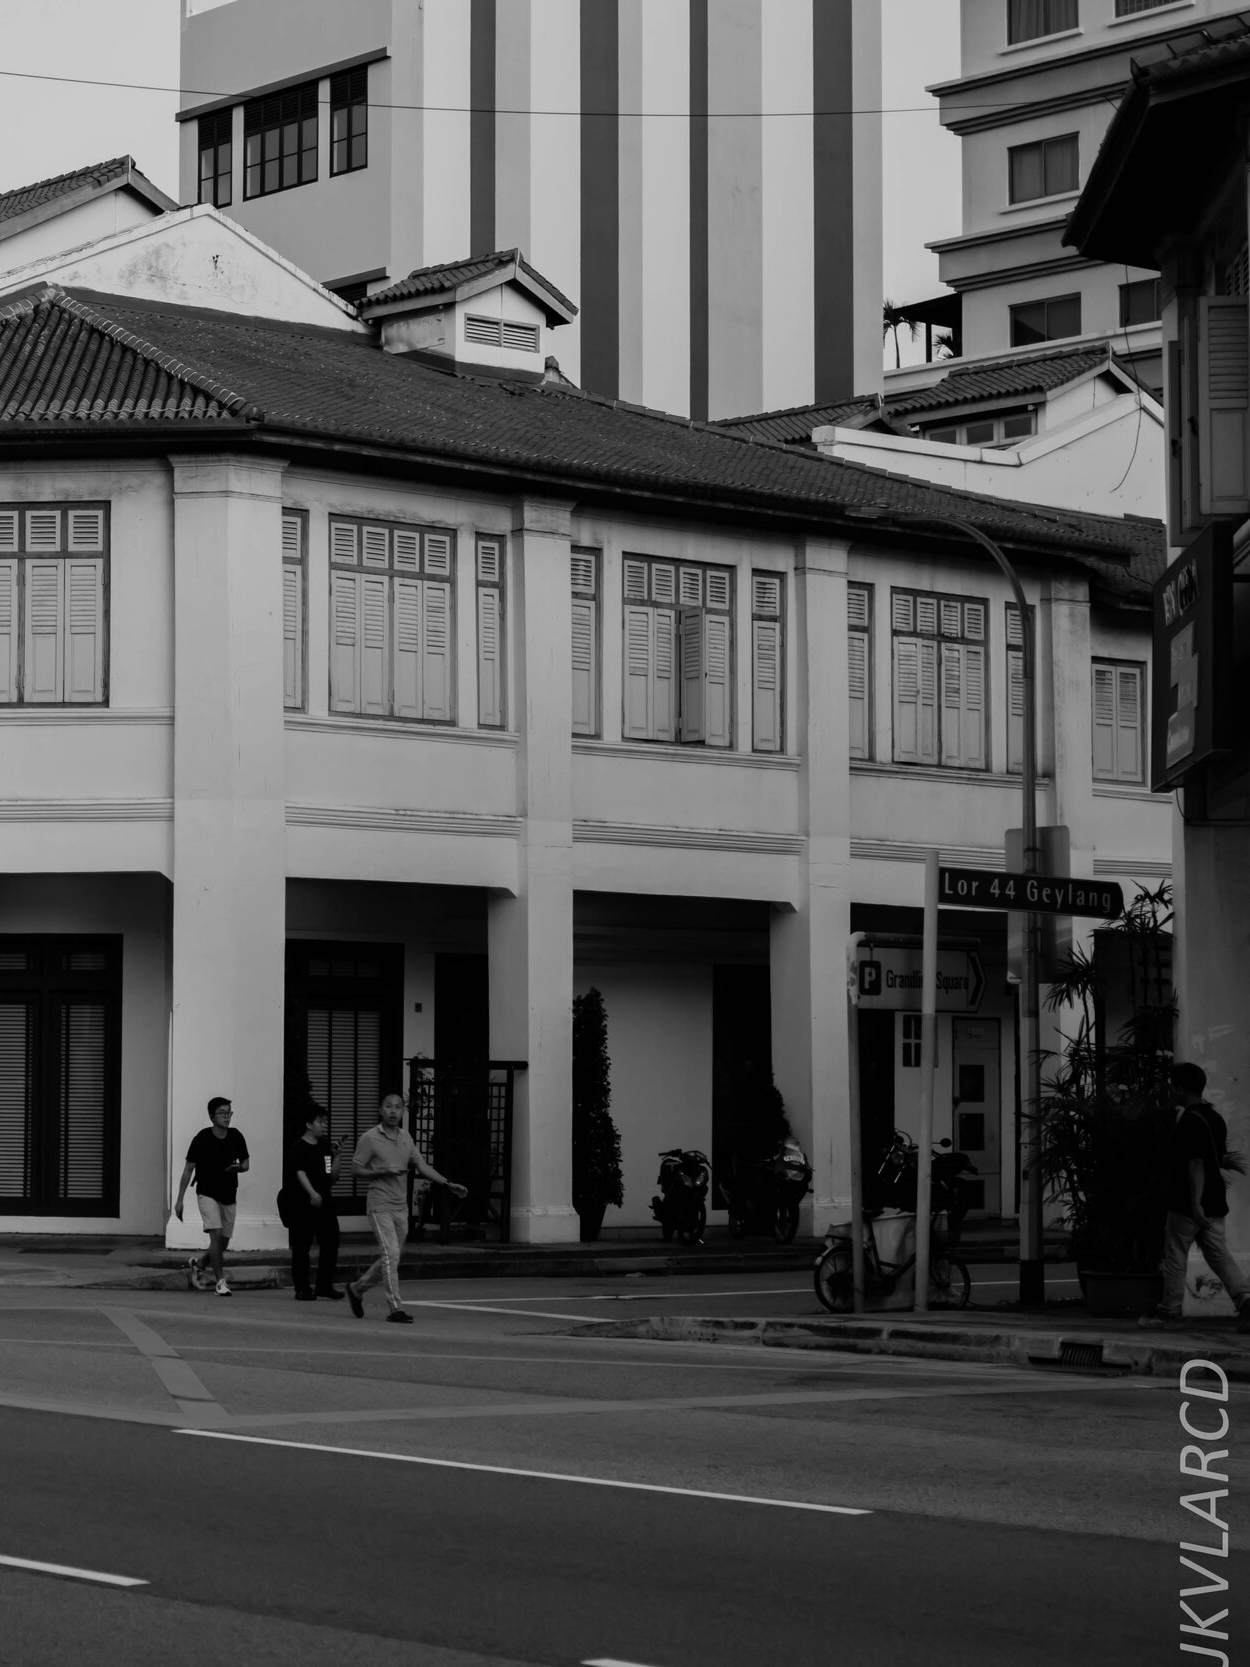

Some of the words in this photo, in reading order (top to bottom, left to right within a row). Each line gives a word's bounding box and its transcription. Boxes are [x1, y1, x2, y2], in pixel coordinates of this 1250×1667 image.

[944, 872, 979, 897] Lor
[989, 878, 1016, 900] 44
[1026, 879, 1111, 915] Geylang
[864, 967, 876, 990] P
[886, 969, 924, 989] Grandli
[936, 971, 969, 995] Square
